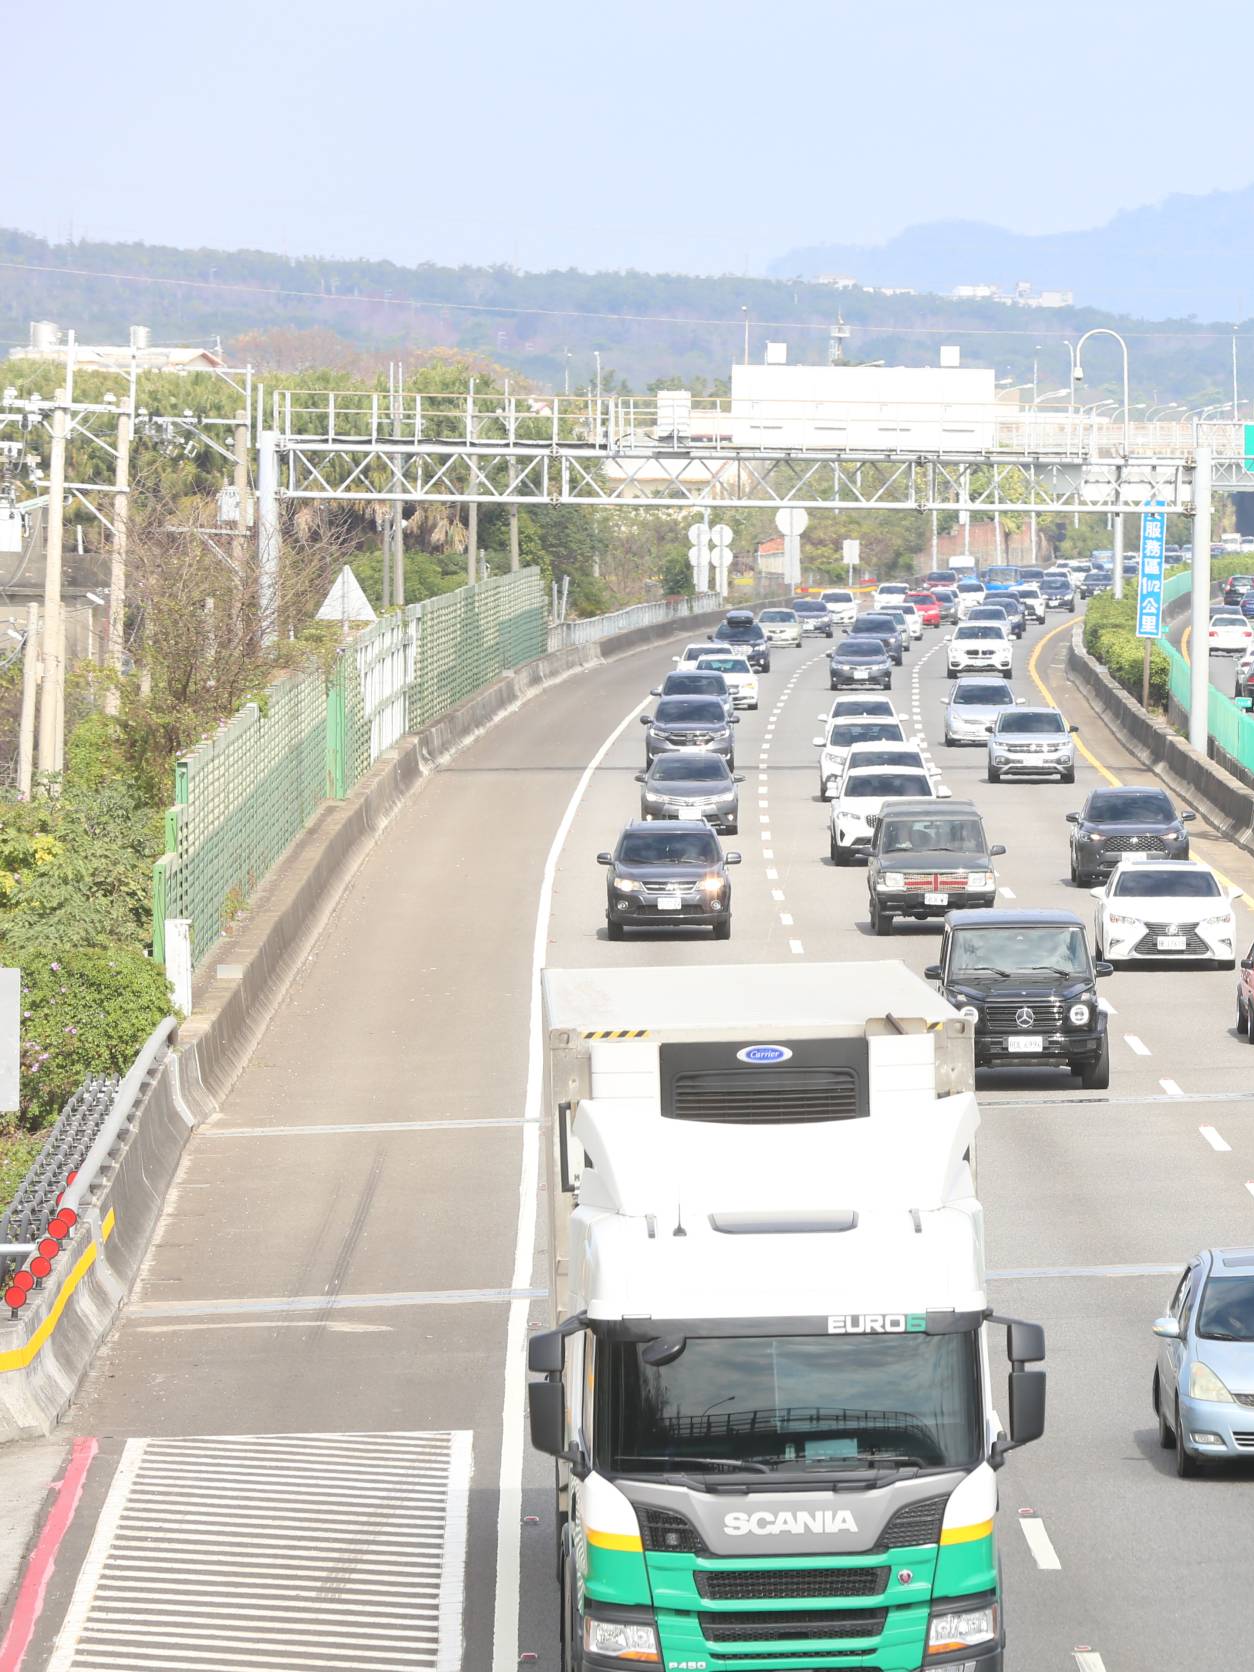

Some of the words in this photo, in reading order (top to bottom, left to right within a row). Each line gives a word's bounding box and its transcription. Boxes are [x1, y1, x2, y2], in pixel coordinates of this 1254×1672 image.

[750, 1050, 780, 1058] Carrier
[827, 1313, 926, 1334] EURO6
[723, 1510, 858, 1536] SCANIA
[668, 1661, 706, 1669] P450
